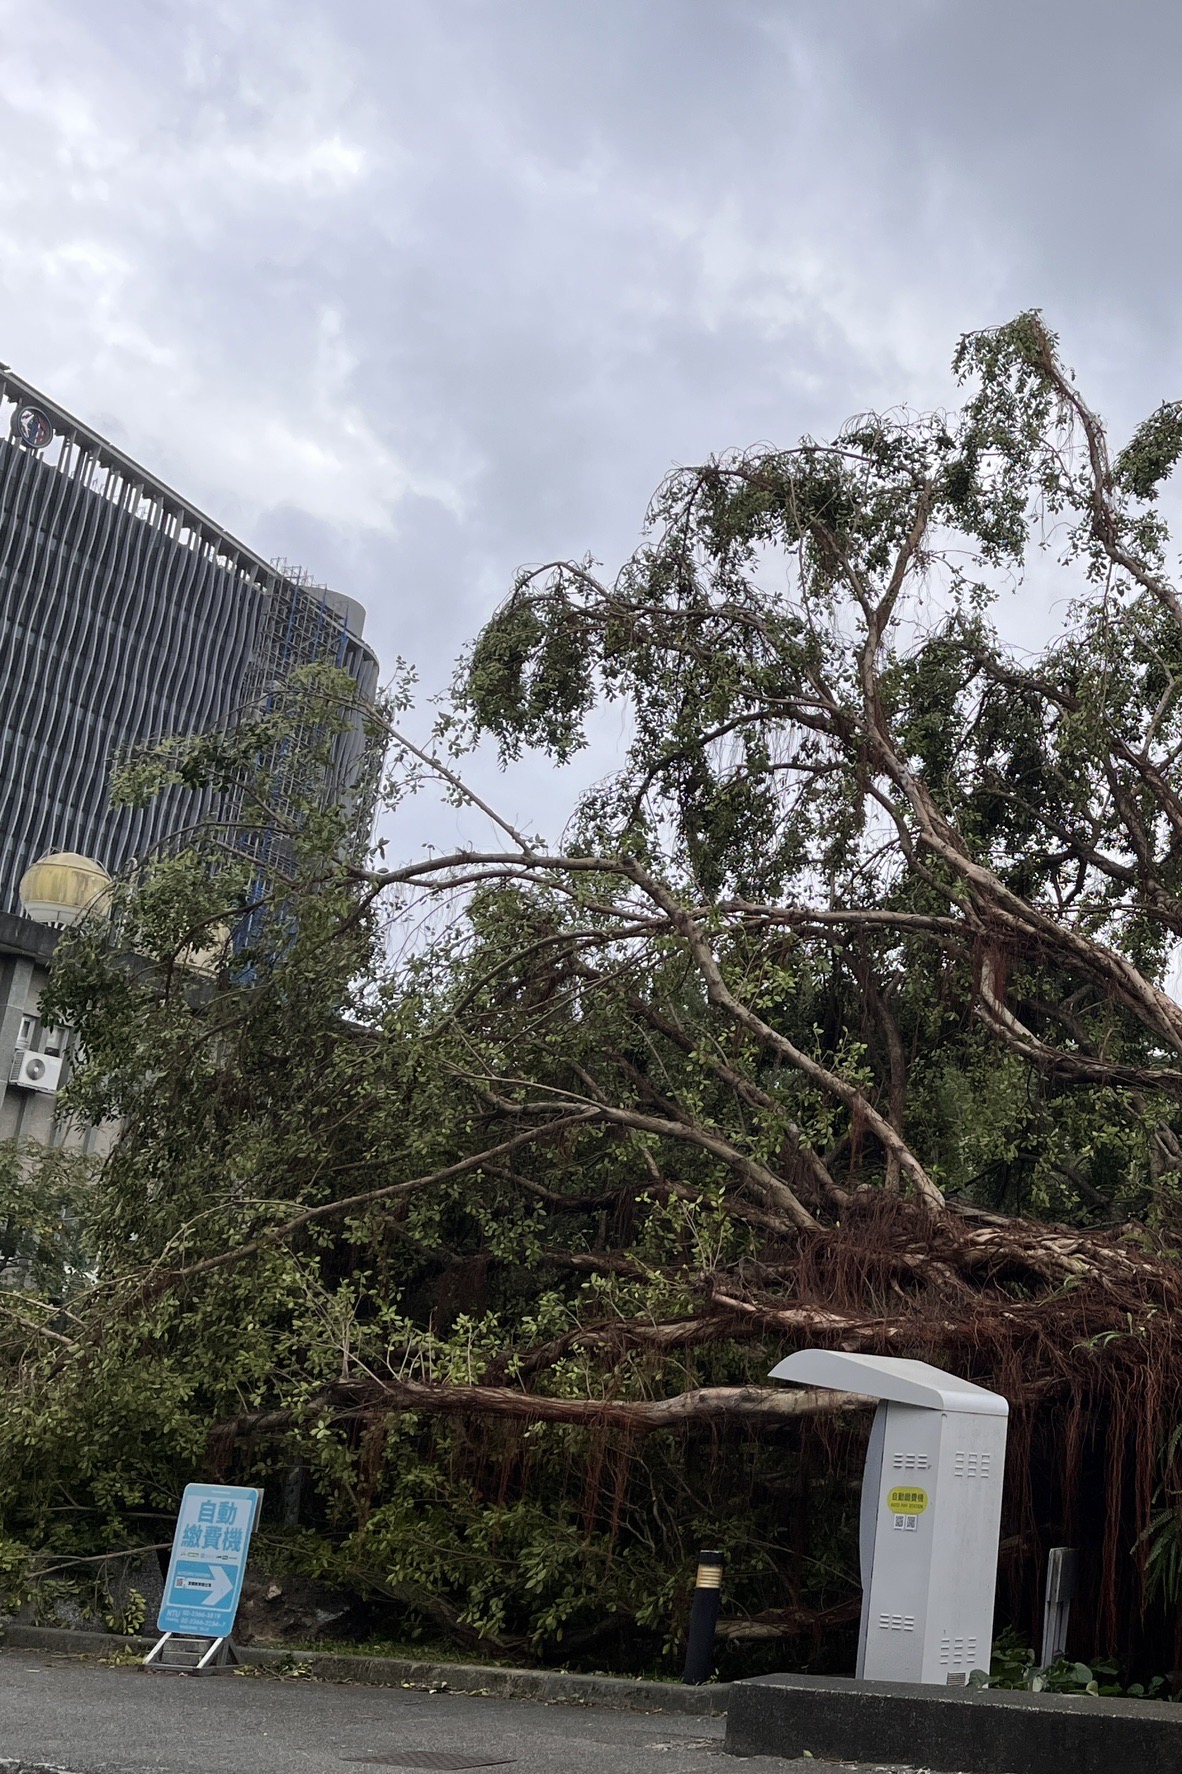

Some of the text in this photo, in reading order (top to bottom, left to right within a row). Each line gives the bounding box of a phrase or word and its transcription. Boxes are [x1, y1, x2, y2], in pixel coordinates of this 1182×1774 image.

[892, 1492, 924, 1502] 自動繳費機
[198, 1499, 238, 1525] 自動
[181, 1523, 243, 1552] 繳費機
[167, 1609, 180, 1617] NTU
